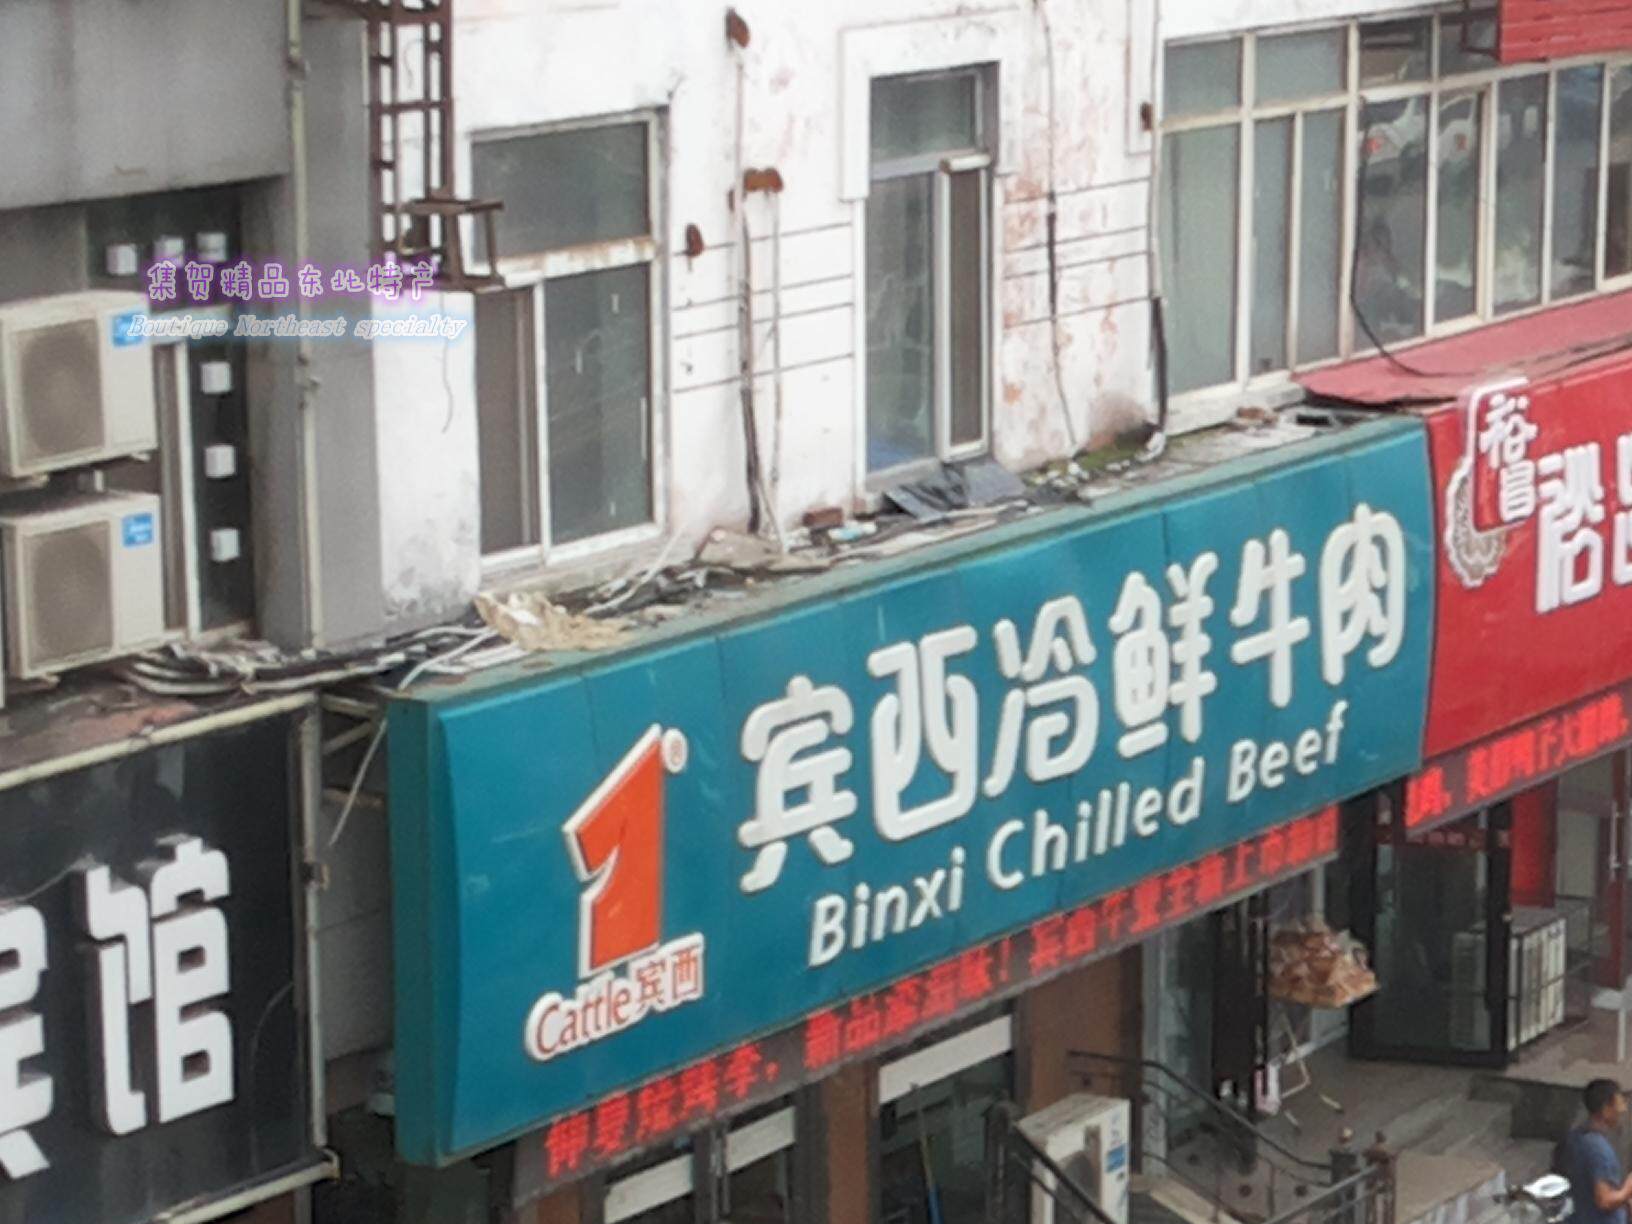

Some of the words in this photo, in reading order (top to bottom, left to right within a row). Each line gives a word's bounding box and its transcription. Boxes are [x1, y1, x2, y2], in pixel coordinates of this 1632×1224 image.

[738, 503, 1406, 893] 宾西冷鲜牛肉
[808, 847, 966, 968] Binxi
[987, 757, 1204, 889] Chilled
[1227, 701, 1347, 802] Beef
[535, 977, 631, 1055] Cattle
[635, 946, 702, 1007] 宾西
